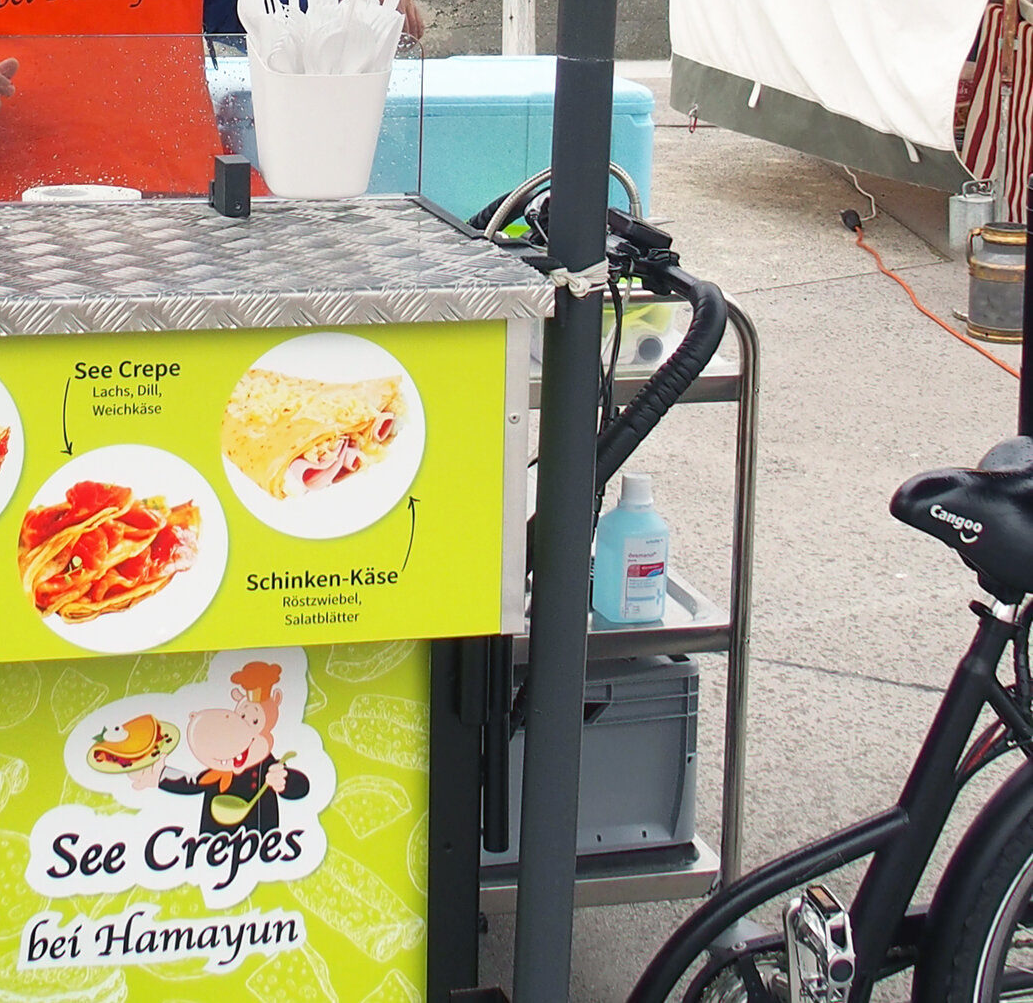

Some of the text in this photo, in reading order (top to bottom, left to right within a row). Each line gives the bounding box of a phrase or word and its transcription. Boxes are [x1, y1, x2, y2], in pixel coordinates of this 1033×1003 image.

[74, 360, 181, 382] See Crepe
[93, 384, 162, 398] Lachs, Dill,
[93, 403, 162, 416] Weichkäse
[930, 504, 983, 533] Cangoo
[246, 567, 399, 591] Schinken-Käse
[282, 592, 362, 607] Röstzwiebel,
[285, 611, 360, 626] Salatblätter
[46, 826, 305, 890] See Crepes
[27, 911, 298, 966] bei Hamayun
